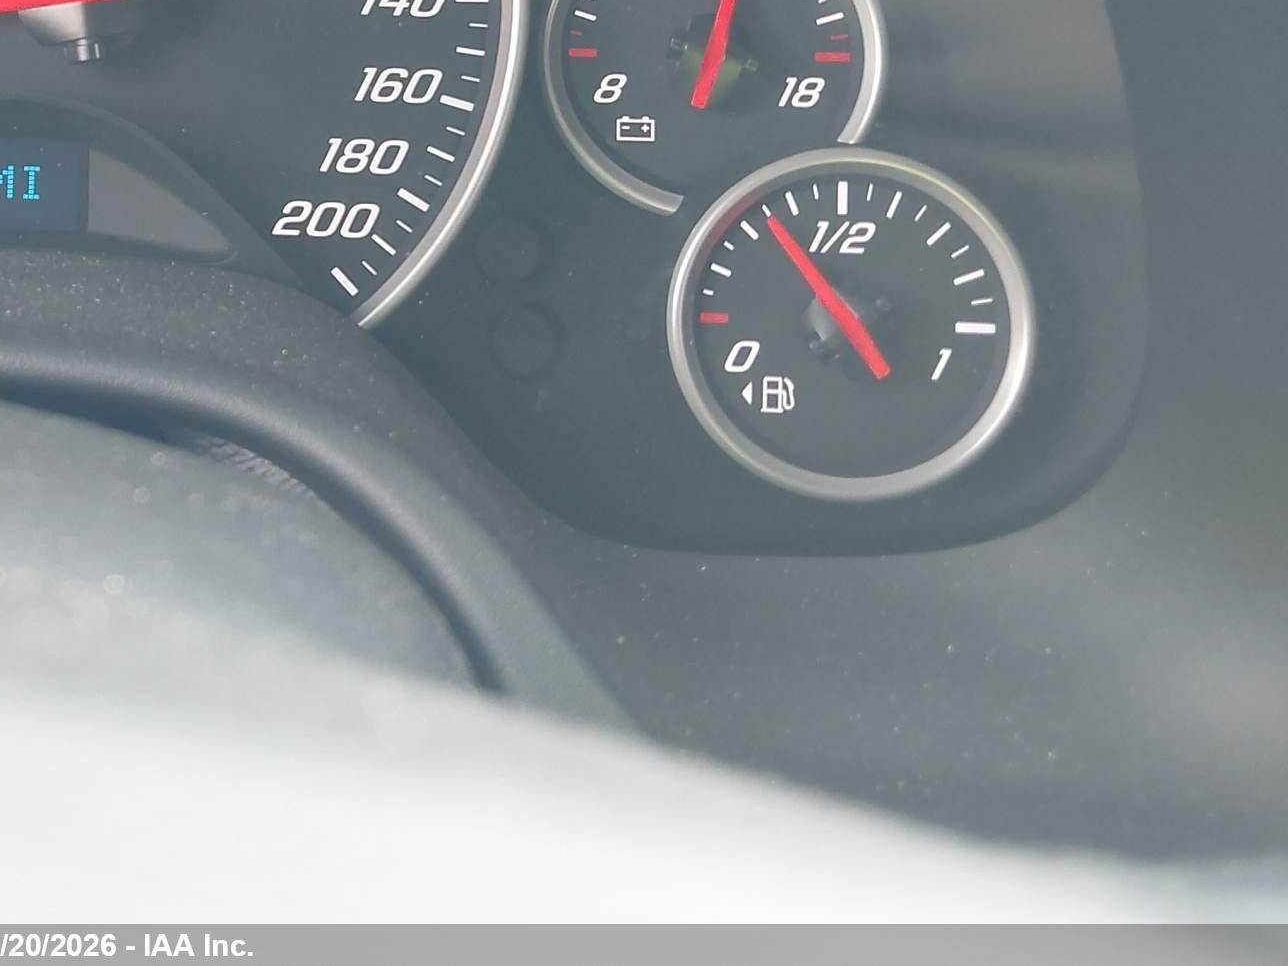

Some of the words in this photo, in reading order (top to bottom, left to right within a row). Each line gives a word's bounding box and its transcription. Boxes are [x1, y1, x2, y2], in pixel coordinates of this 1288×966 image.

[354, 67, 443, 104] 160
[593, 73, 628, 104] 8
[778, 76, 826, 108] 18
[319, 137, 410, 175] 180
[271, 200, 380, 238] 200
[808, 220, 877, 255] 1/2
[724, 340, 761, 373] 0
[931, 348, 952, 381] 1
